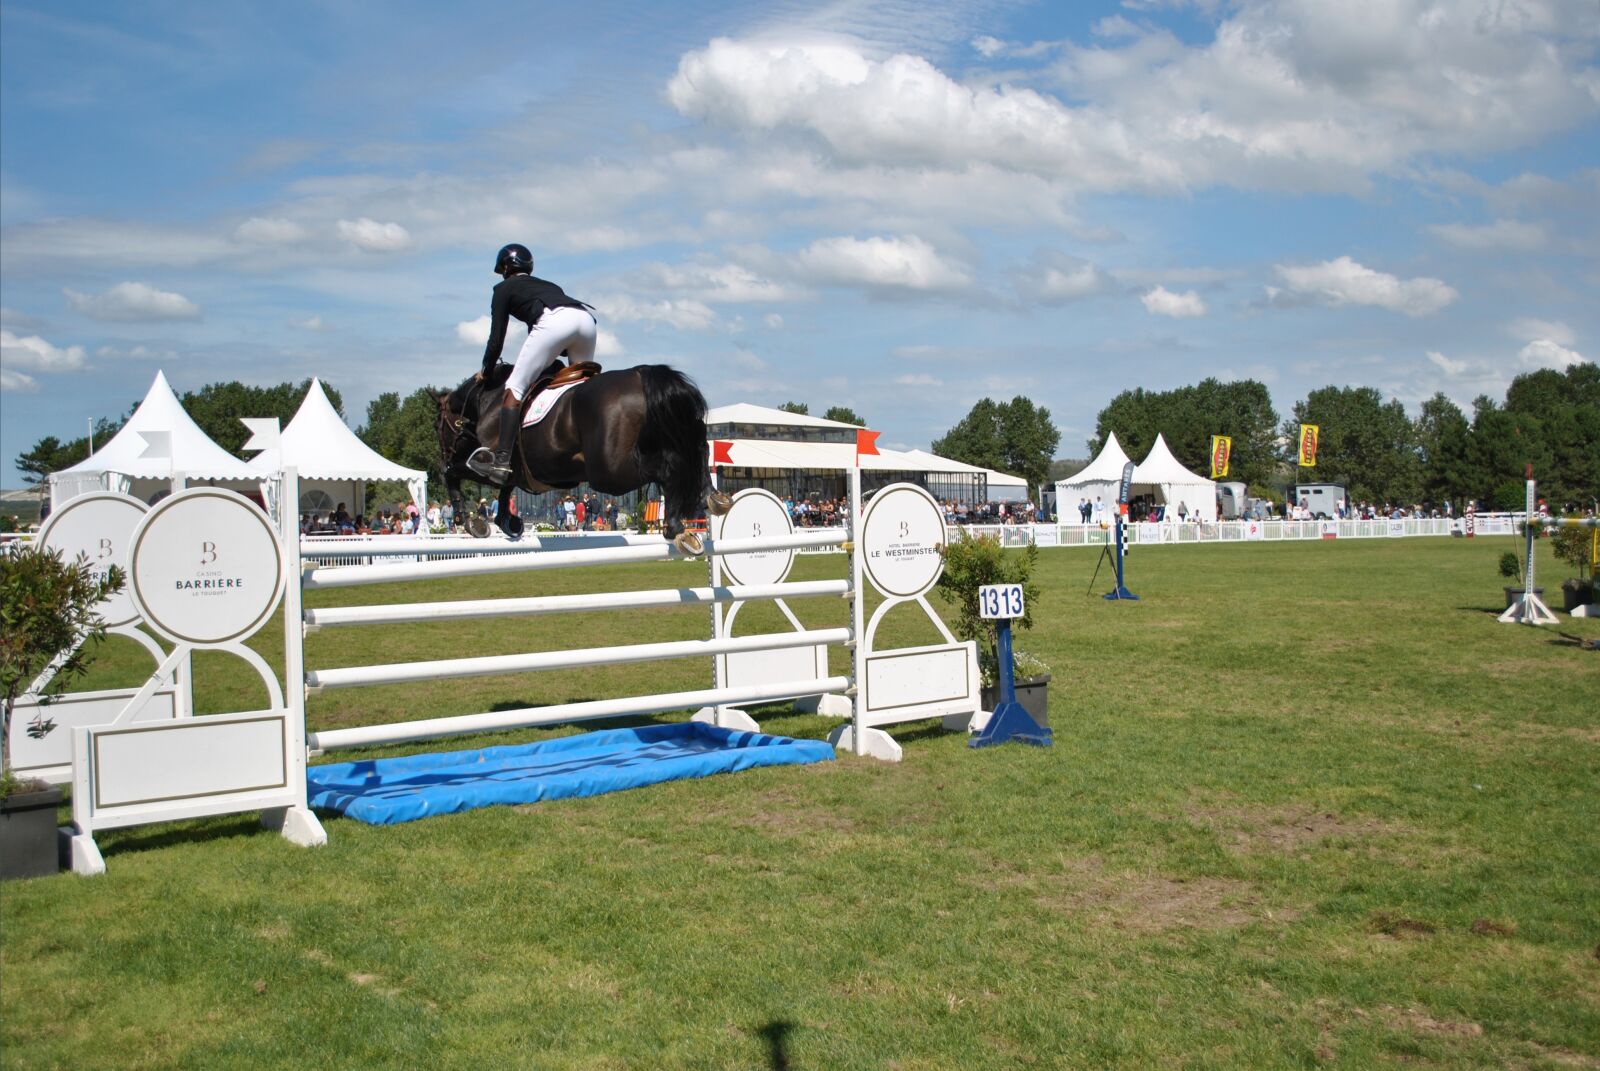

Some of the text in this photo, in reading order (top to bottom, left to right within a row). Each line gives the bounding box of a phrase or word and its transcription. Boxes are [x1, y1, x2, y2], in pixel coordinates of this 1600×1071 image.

[1466, 513, 1474, 534] CWD
[871, 547, 938, 558] LE WESTMINSTER
